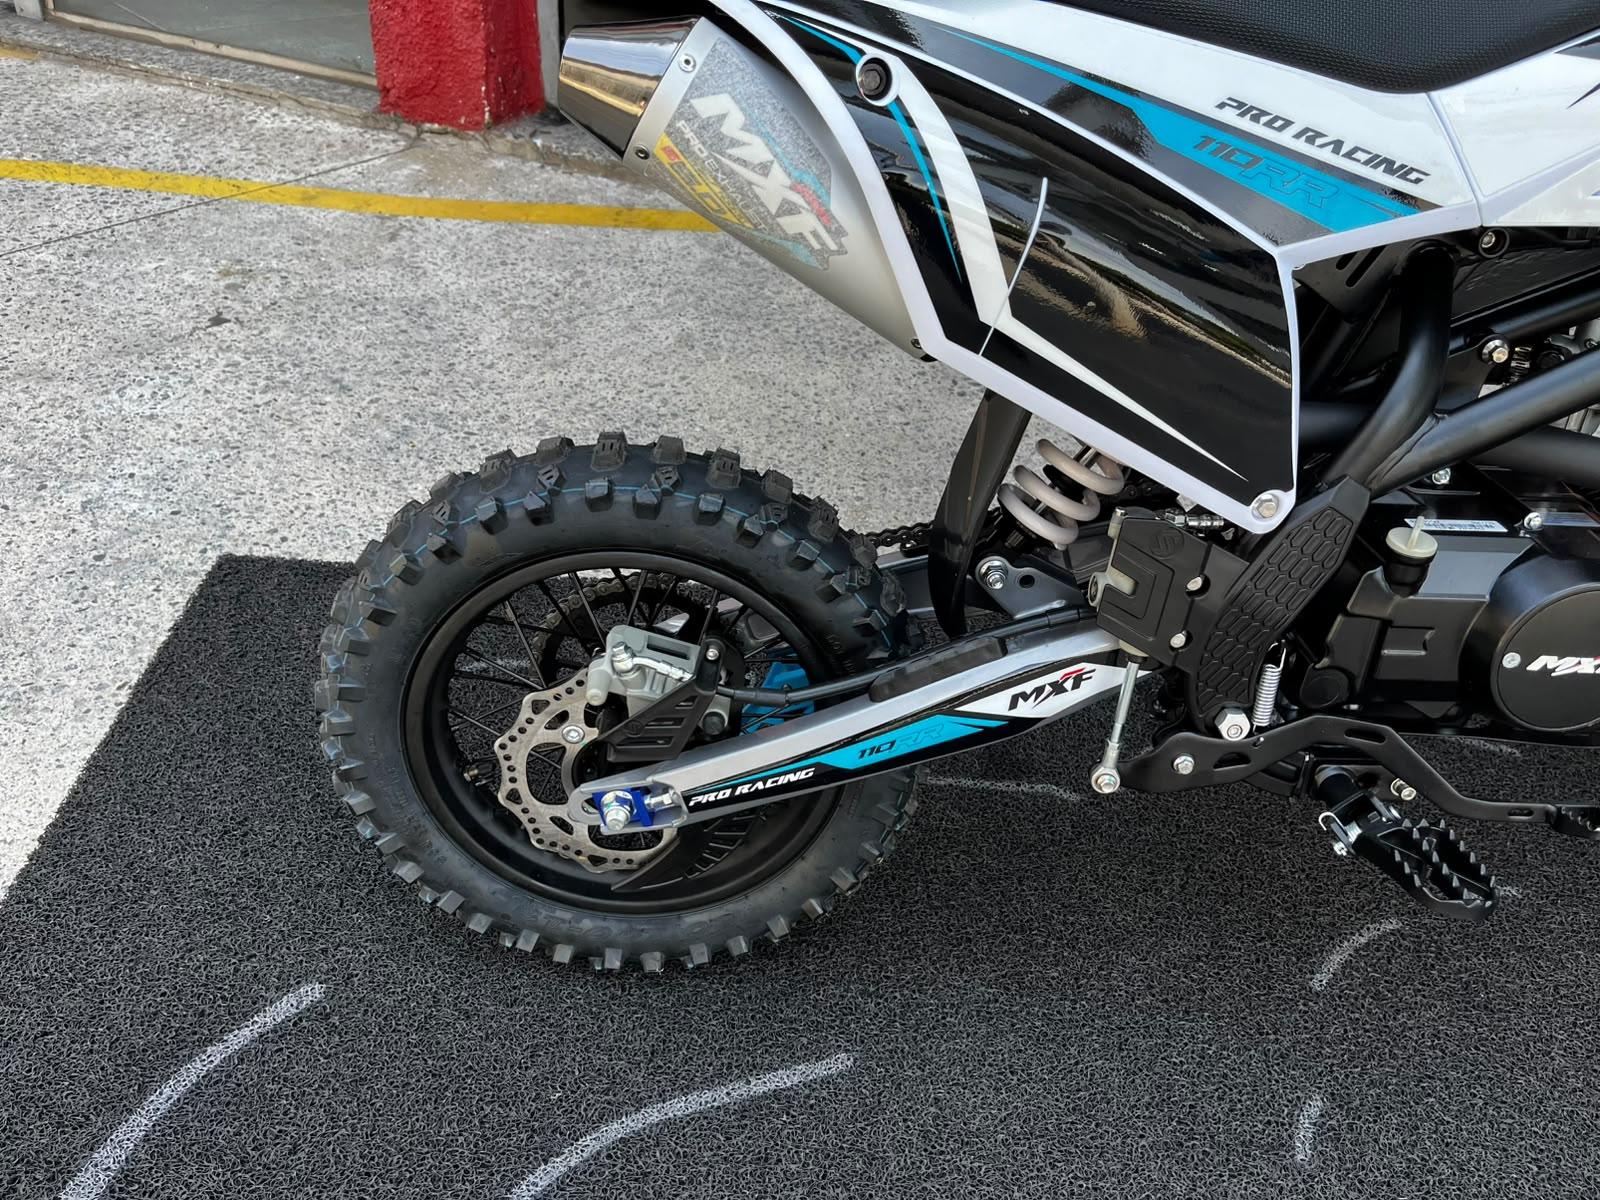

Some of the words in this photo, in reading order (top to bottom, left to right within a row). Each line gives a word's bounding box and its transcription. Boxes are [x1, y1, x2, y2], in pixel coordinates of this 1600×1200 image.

[690, 93, 838, 250] MXF
[1215, 97, 1295, 132] PRO
[1292, 127, 1430, 185] RACING
[676, 120, 708, 158] PRO
[705, 159, 768, 231] EXHAUST
[1008, 667, 1096, 711] MXF
[1526, 655, 1600, 676] MX
[688, 789, 731, 806] PRO
[735, 768, 815, 795] RACING
